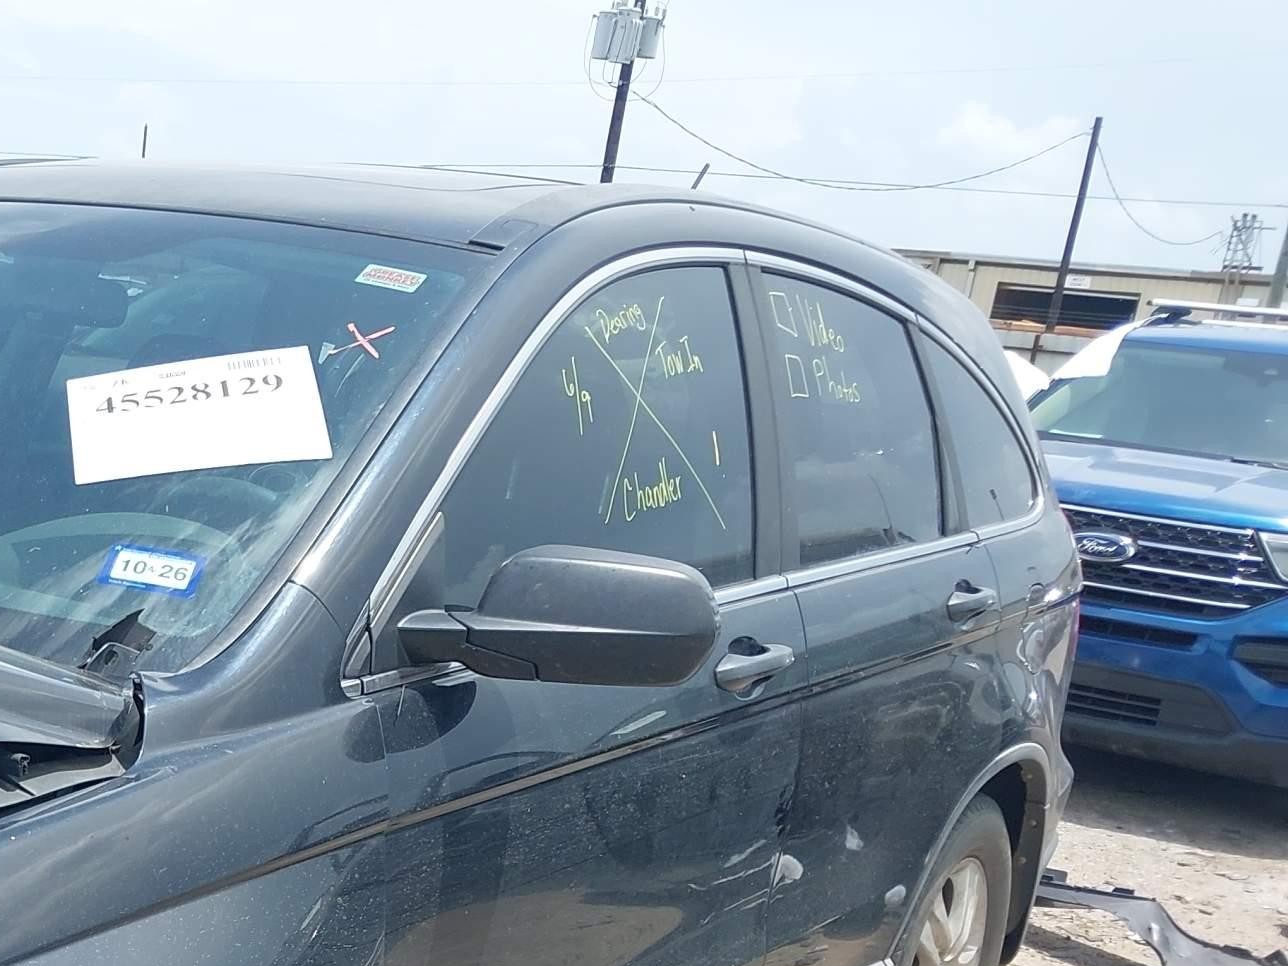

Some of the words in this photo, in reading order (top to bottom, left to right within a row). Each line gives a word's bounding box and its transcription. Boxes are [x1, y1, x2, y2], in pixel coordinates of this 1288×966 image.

[795, 294, 844, 352] Video
[96, 374, 283, 413] 45528129
[812, 356, 860, 402] Photos
[623, 457, 682, 521] Chandler
[1078, 537, 1120, 553] Ford
[122, 559, 147, 575] 10
[158, 564, 189, 581] 26
